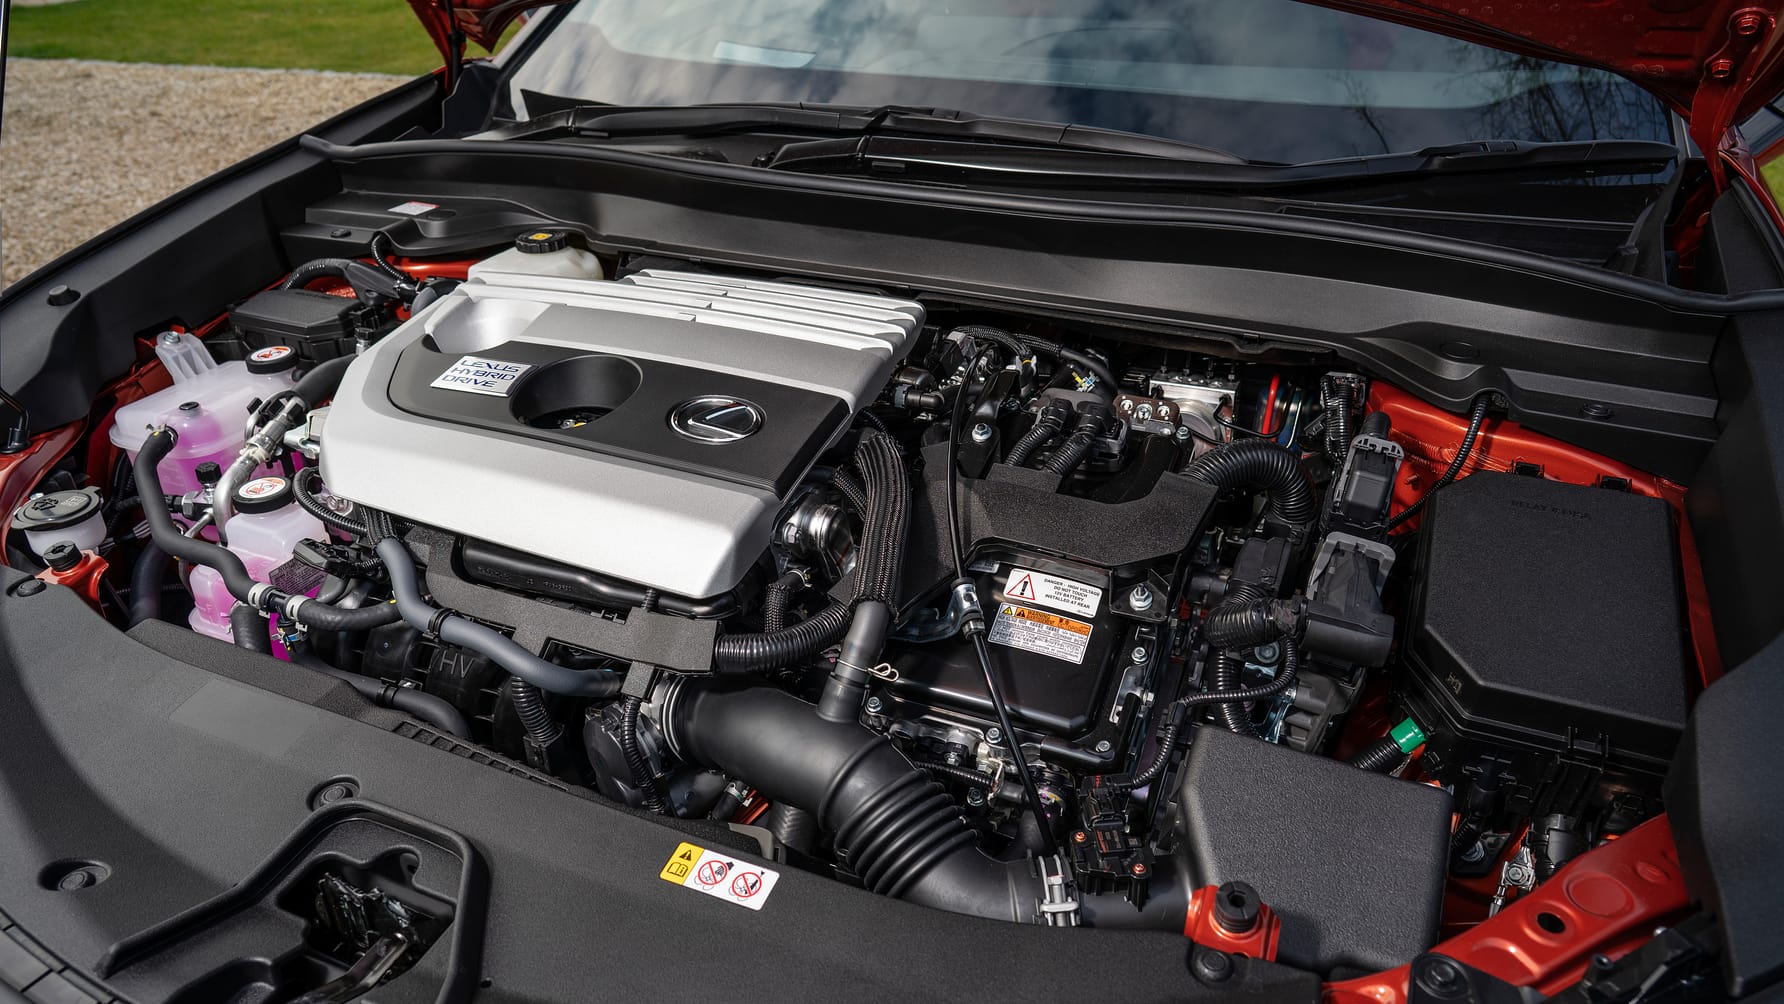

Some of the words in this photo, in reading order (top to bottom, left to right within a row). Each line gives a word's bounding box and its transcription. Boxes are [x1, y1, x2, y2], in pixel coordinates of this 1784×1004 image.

[461, 360, 521, 373] LEXUS
[451, 367, 516, 381] HYBRID
[442, 374, 498, 388] DRIVE
[1044, 578, 1063, 586] DANGER
[1080, 586, 1100, 597] VOLTAGE
[1072, 590, 1088, 598] TOUCH
[1045, 594, 1070, 604] INSTALLED
[1062, 593, 1084, 602] BATTERY
[440, 650, 474, 678] HV
